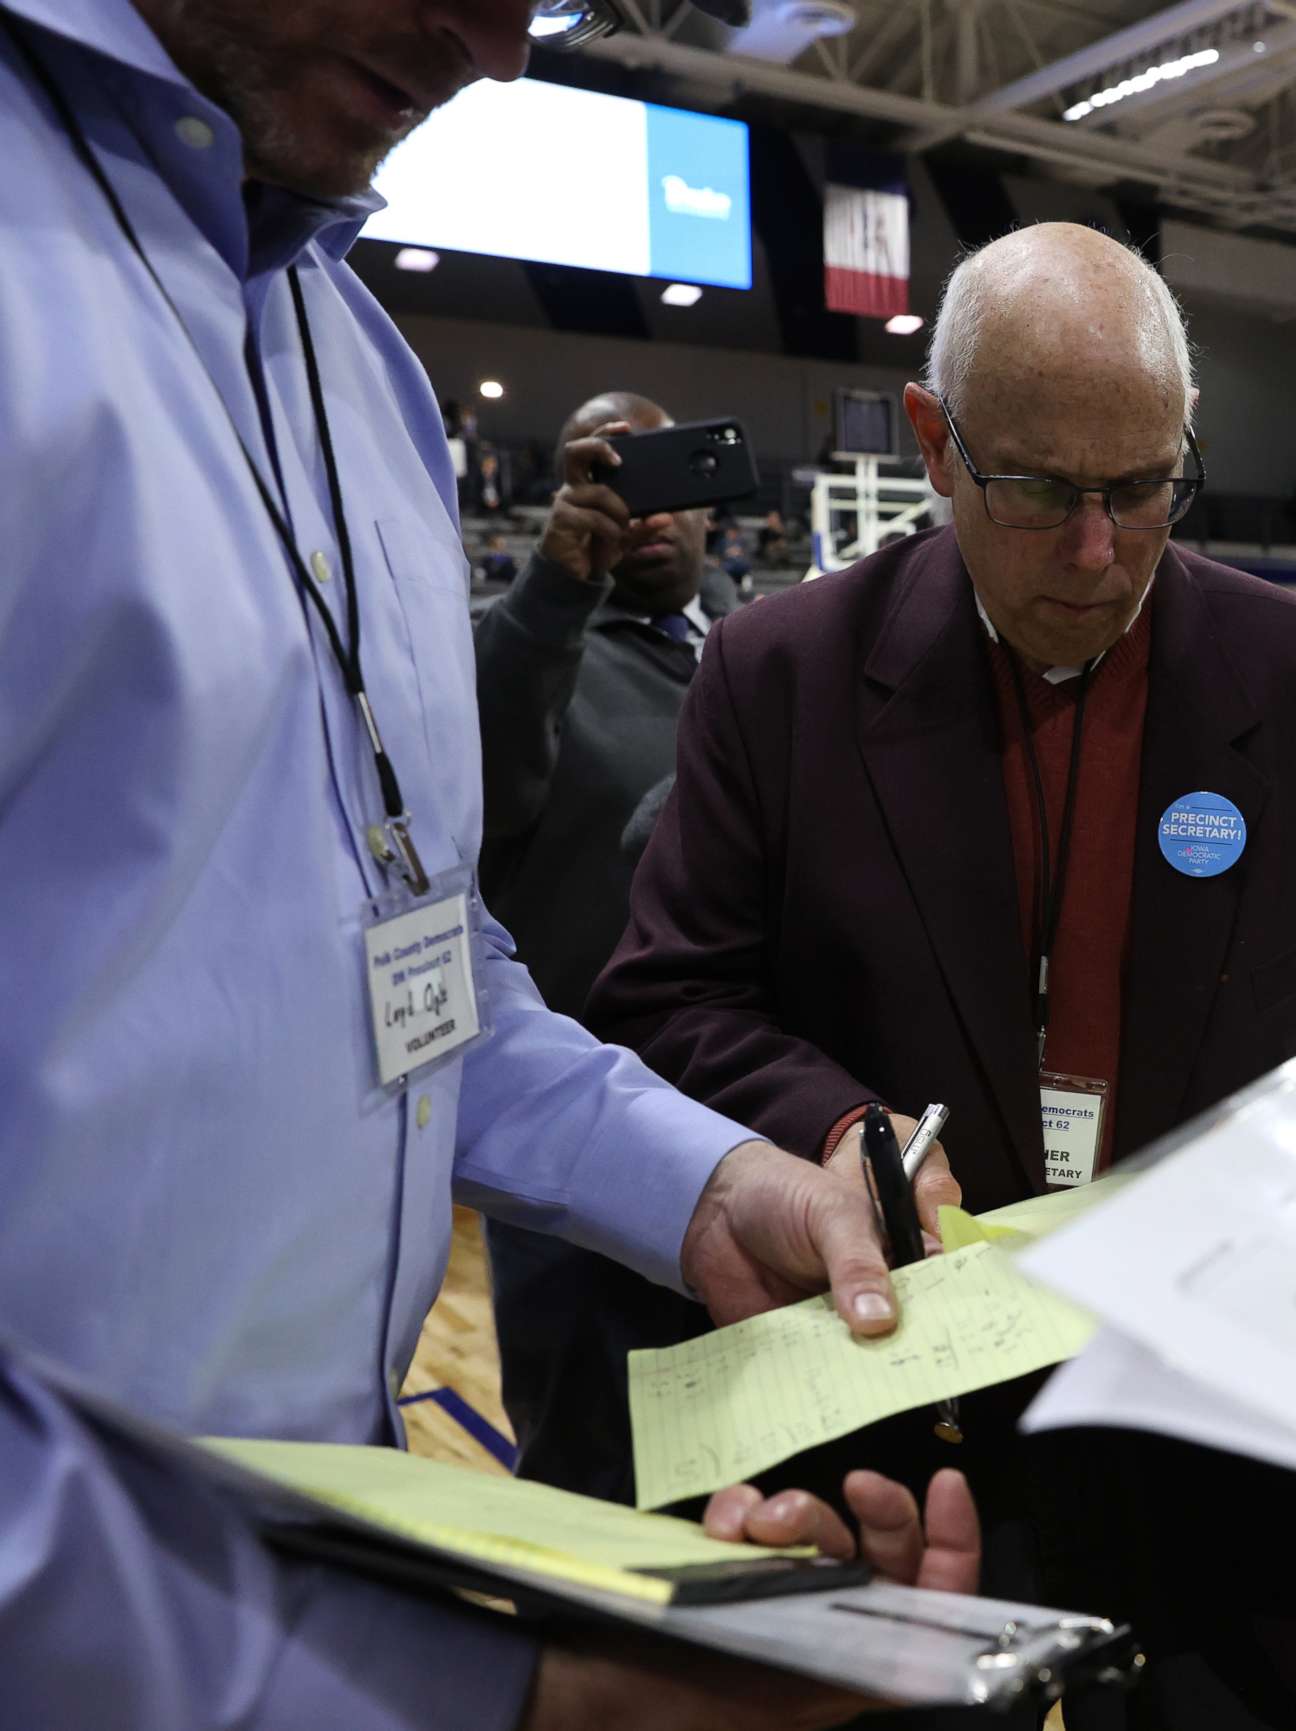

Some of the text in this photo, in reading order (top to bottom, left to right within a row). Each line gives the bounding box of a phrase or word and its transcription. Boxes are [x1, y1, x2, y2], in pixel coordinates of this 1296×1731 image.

[1171, 812, 1237, 827] PRECINCT
[1163, 824, 1241, 840] SECRETARY!
[405, 1018, 456, 1053] VOLUNTEER
[1041, 1105, 1094, 1118] emocrats
[1056, 1120, 1071, 1130] 62
[1045, 1166, 1083, 1180] ETARY
